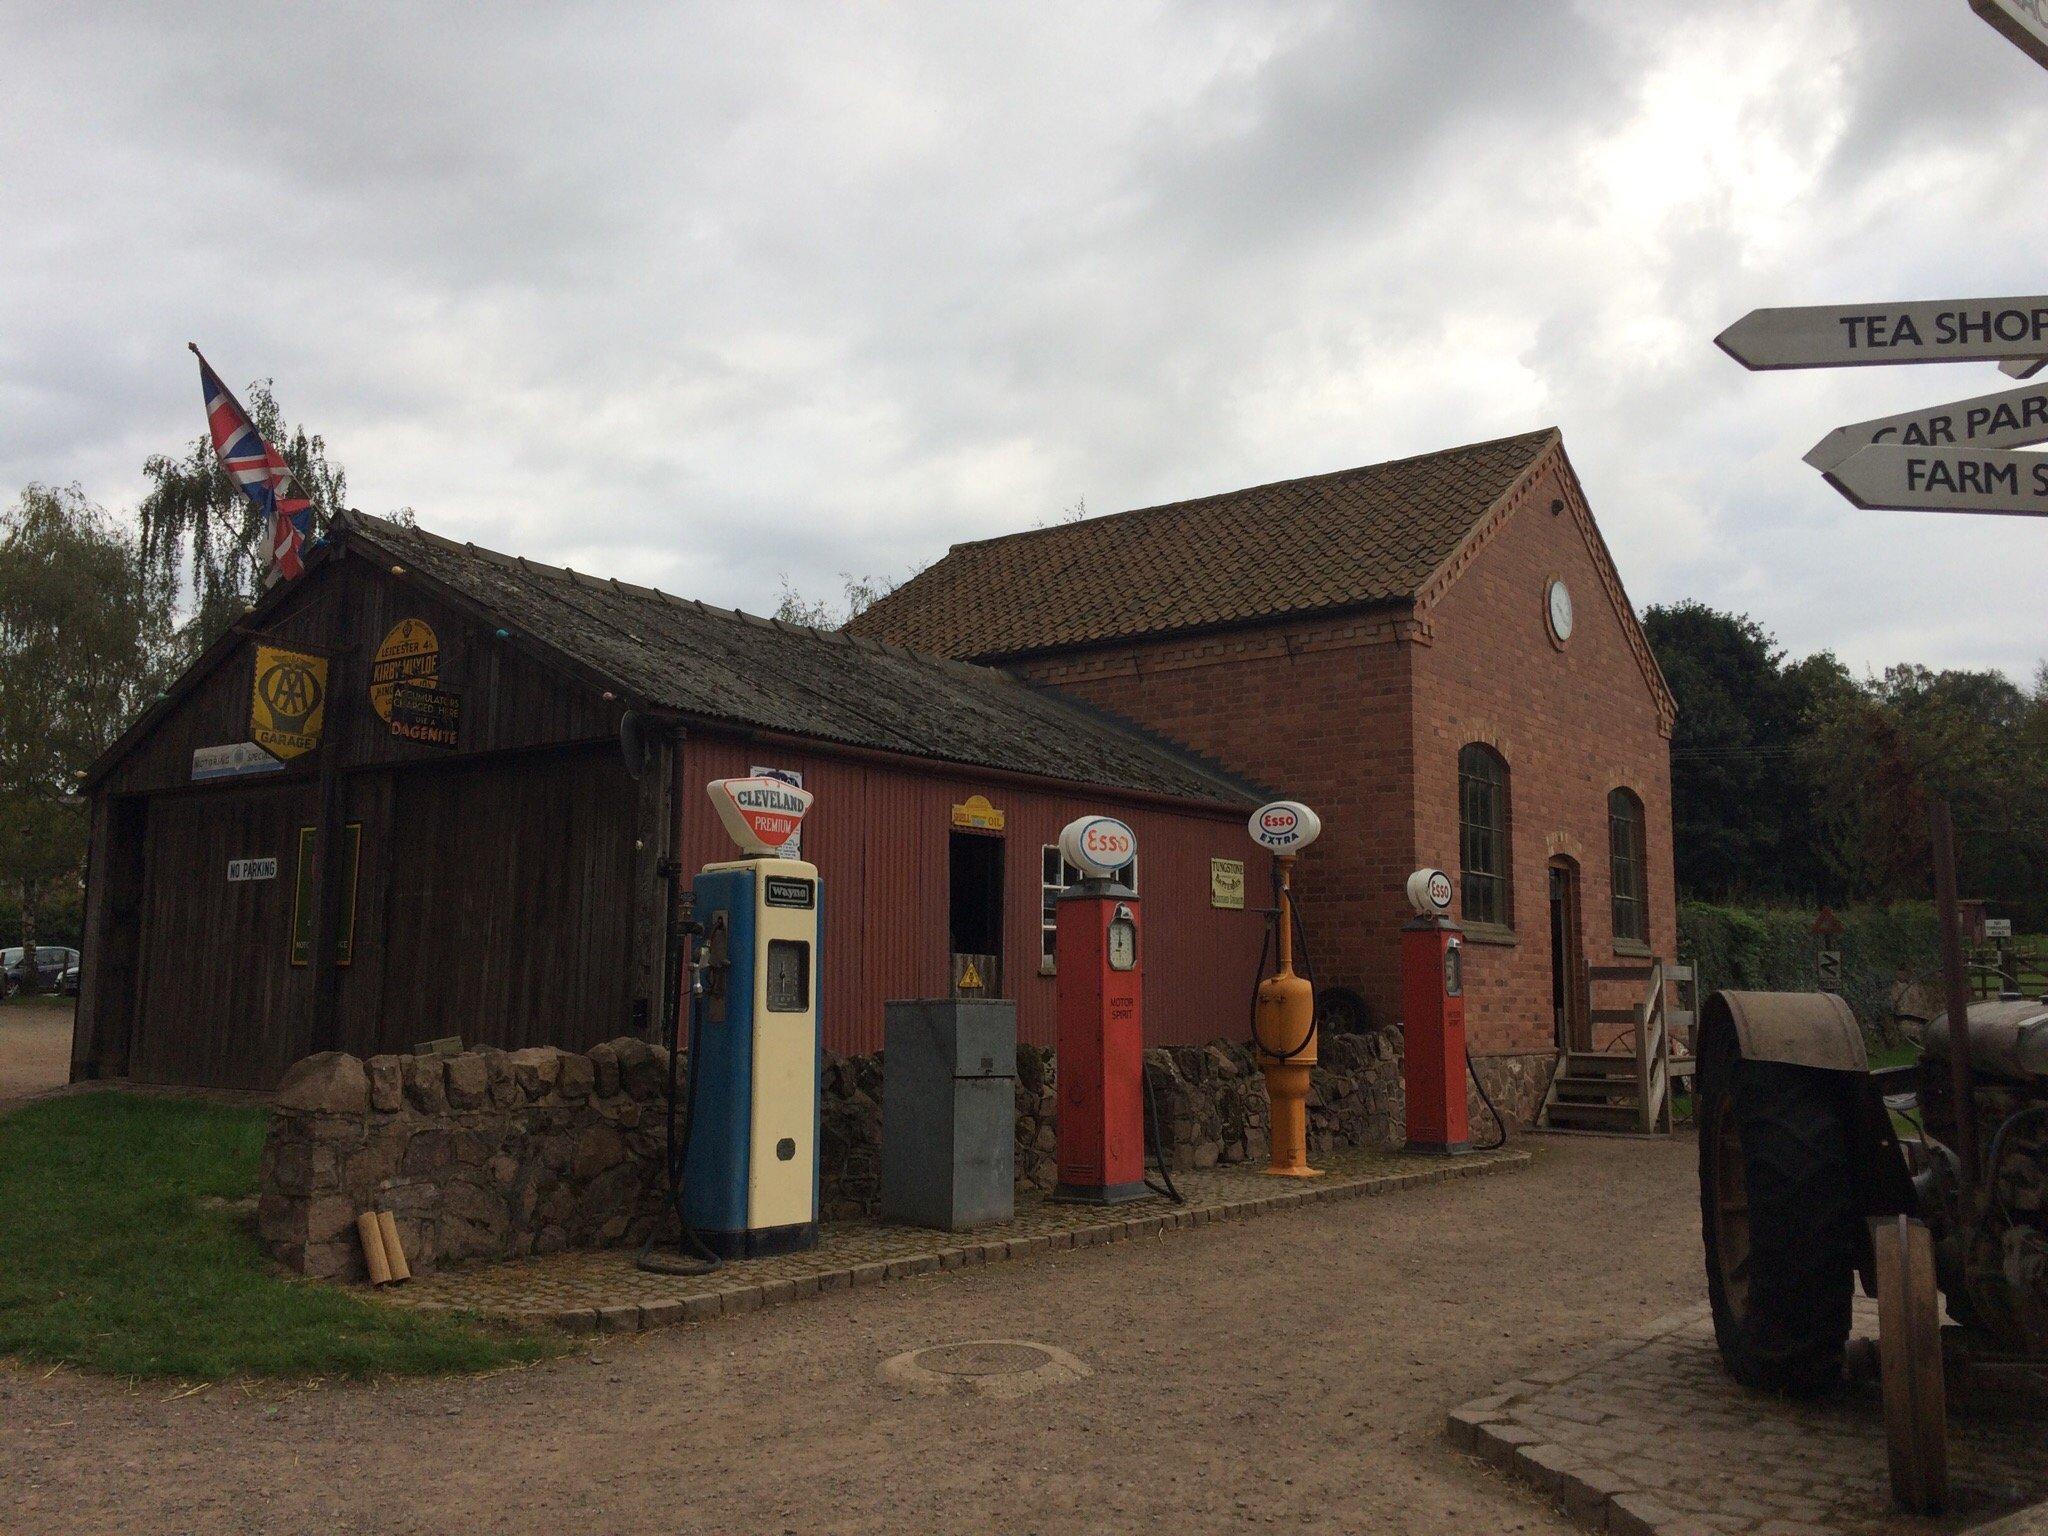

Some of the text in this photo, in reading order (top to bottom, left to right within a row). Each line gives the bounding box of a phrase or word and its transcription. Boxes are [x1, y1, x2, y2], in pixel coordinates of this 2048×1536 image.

[1839, 308, 2048, 348] TEA SHOP
[1967, 395, 2048, 439] PAR
[1906, 459, 2048, 497] FARM S
[381, 642, 419, 658] LEICESTER
[260, 731, 313, 749] GARAGE
[391, 721, 459, 745] DAGENITE
[737, 789, 804, 813] CLEVELAND
[755, 816, 792, 834] PREMIUM
[1264, 815, 1294, 827] Esso
[1087, 829, 1129, 853] Esso
[1259, 833, 1299, 845] EXTRA
[230, 861, 275, 878] NO PARKING
[771, 886, 807, 899] Wayne
[1110, 997, 1134, 1007] MOTOR
[1111, 1010, 1132, 1020] SPIRIT
